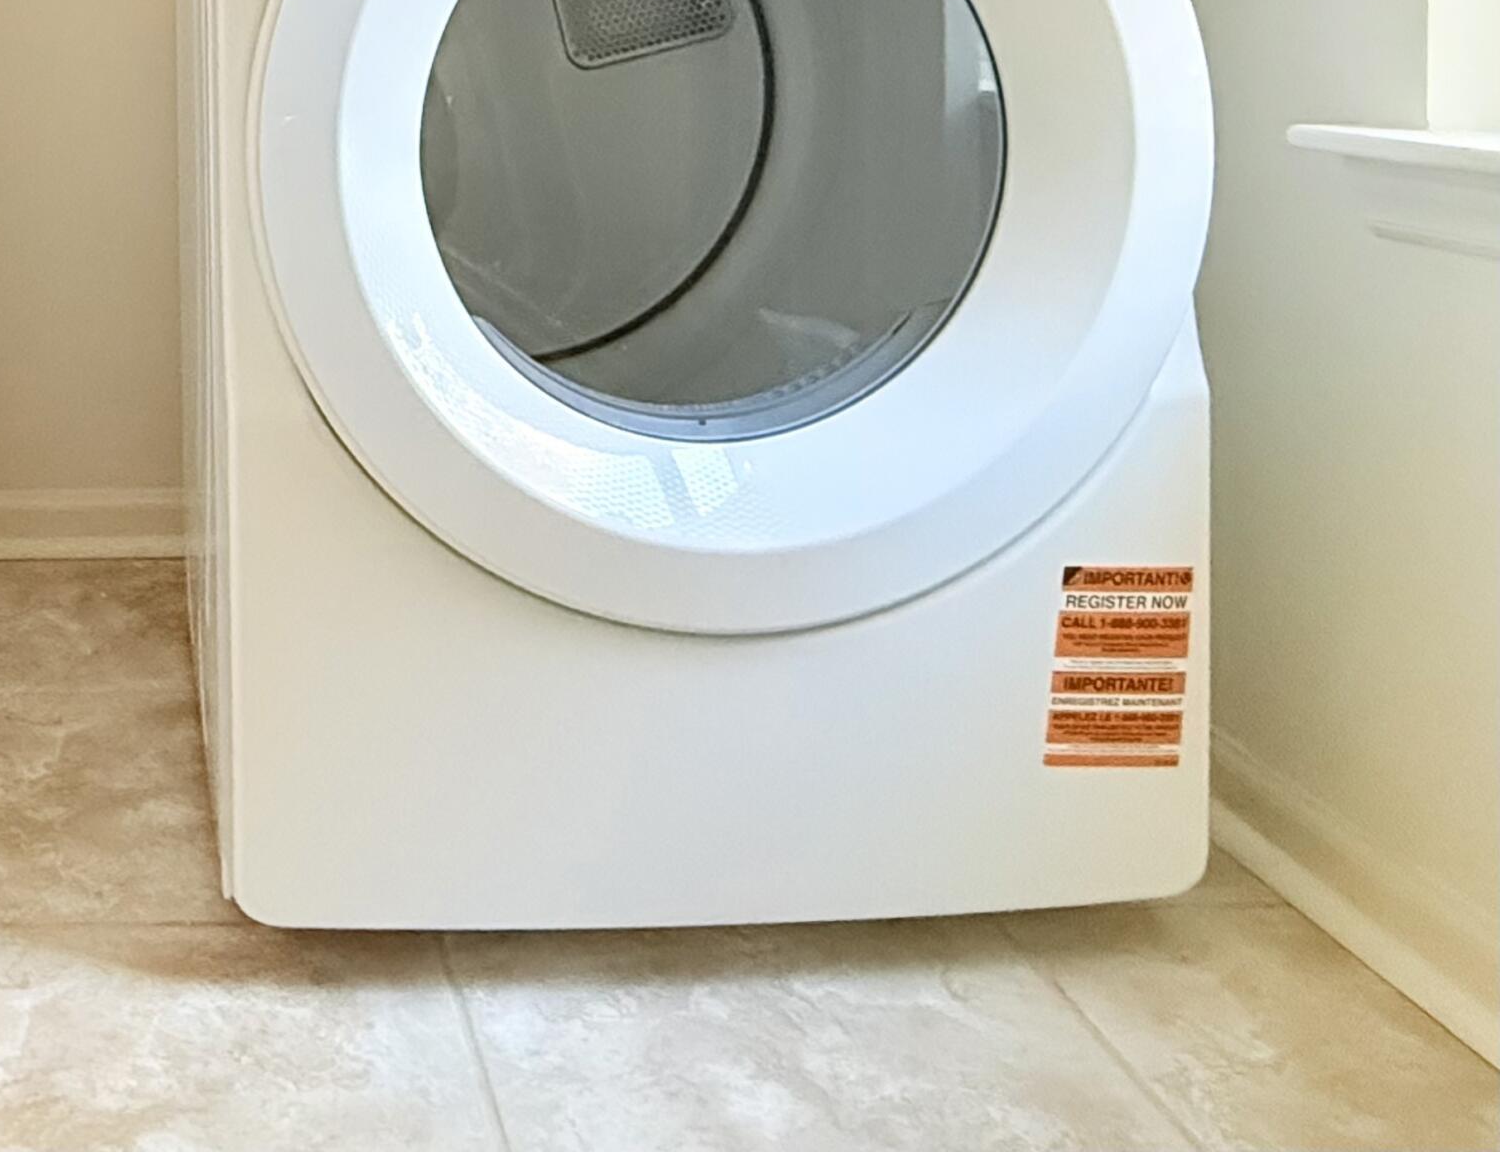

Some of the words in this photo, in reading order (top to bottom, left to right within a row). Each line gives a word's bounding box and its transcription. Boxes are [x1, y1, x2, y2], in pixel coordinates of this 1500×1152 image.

[1083, 571, 1179, 586] IMPORTANT!
[1066, 594, 1147, 609] REGISTER
[1151, 595, 1188, 609] NOW
[1061, 617, 1096, 628] CALL
[1063, 677, 1174, 691] IMPORTANTE!
